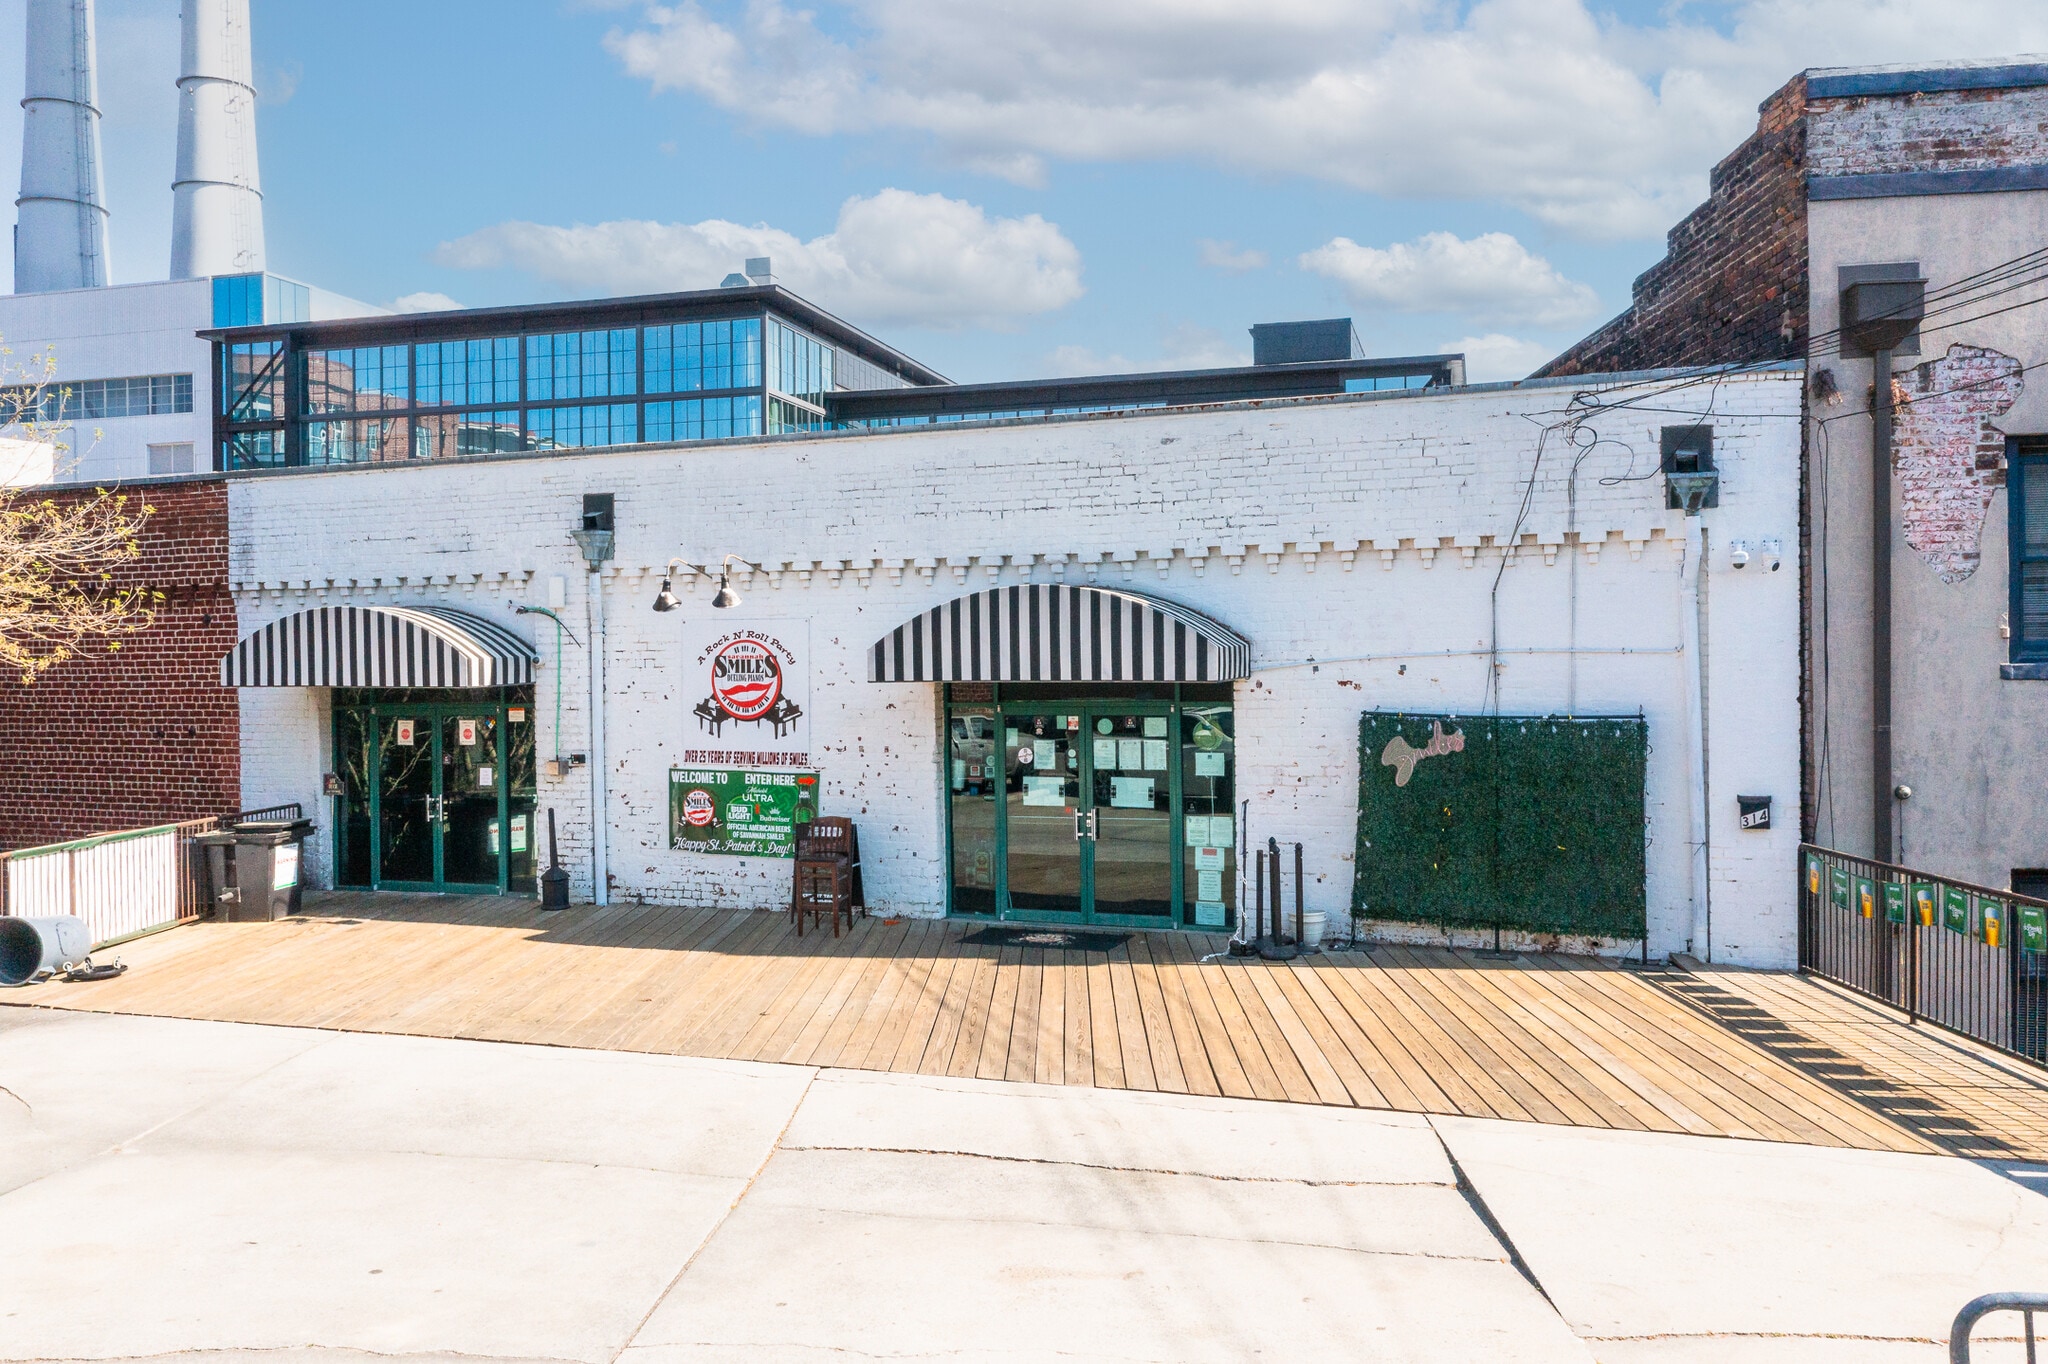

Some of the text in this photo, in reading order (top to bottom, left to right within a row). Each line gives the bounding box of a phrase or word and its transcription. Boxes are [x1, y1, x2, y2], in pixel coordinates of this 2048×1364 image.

[705, 634, 730, 656] Rock
[746, 630, 769, 643] Roll
[770, 638, 796, 666] Party
[714, 655, 778, 678] SMILES
[684, 749, 809, 766] OVER 25 YEARS OF SERVING MILLIONS OF SMILES
[671, 771, 728, 785] WELCOME TO
[744, 773, 796, 786] ENTER HERE
[742, 793, 775, 803] ULTRA
[730, 805, 748, 813] BUD
[728, 812, 751, 820] LIGHT
[760, 814, 791, 823] Budweiser
[726, 823, 791, 833] OFFICIAL AMERICAN BEERS
[740, 831, 767, 840] SAVANNAH
[766, 832, 785, 841] SMILES
[671, 836, 707, 853] Happy
[721, 839, 763, 853] Patrick's
[764, 841, 791, 858] Day!
